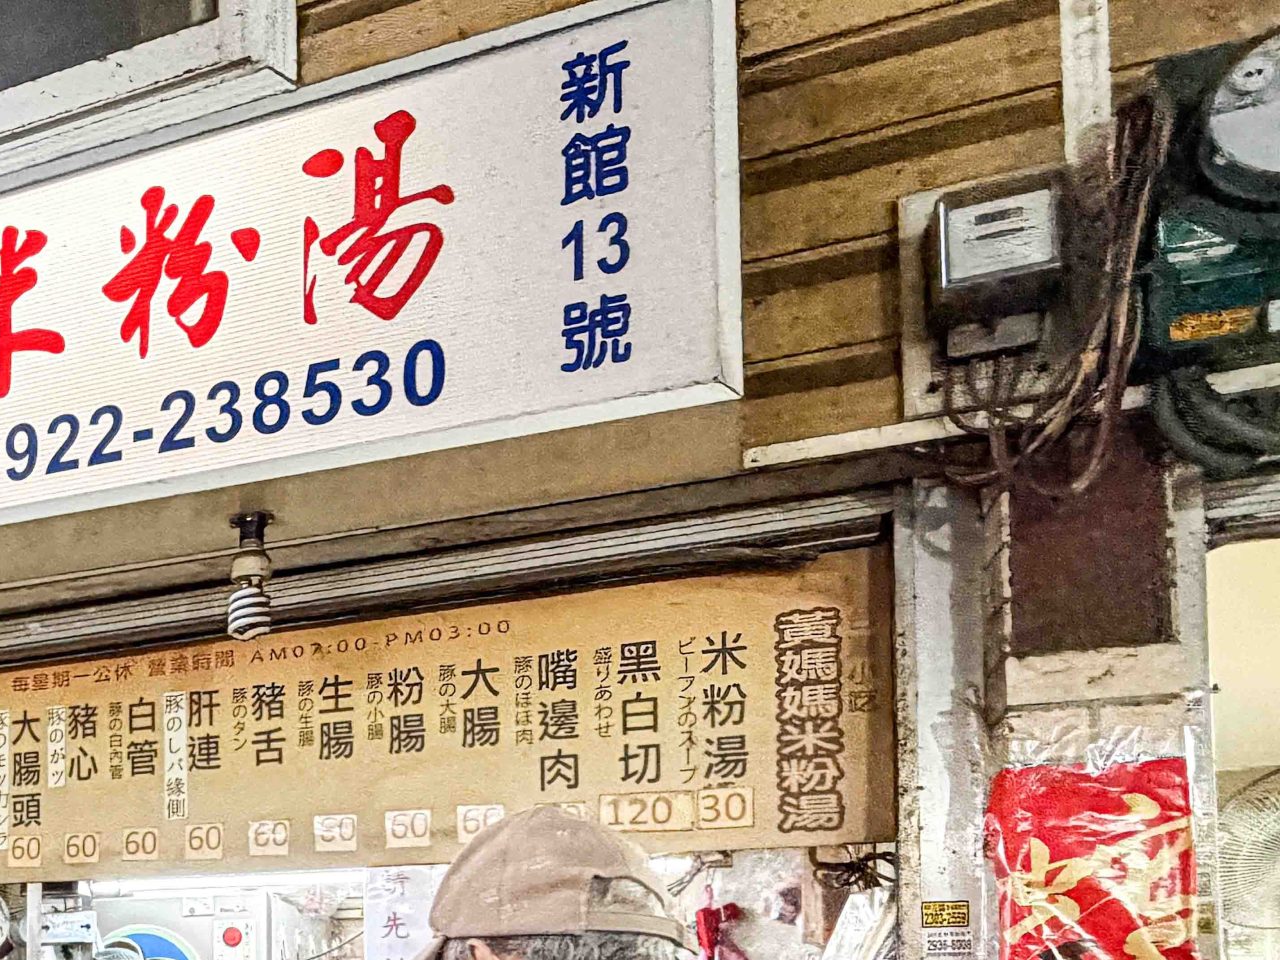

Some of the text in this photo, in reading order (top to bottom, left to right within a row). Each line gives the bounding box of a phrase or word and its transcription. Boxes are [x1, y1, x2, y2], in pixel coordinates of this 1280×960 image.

[560, 39, 632, 373] 新館13號
[10, 661, 134, 692] 每星期一公休
[318, 674, 355, 761] 生腸
[386, 666, 426, 755] 粉腸
[460, 658, 502, 748] 大腸
[592, 646, 616, 739] 盛りあわせ
[617, 640, 662, 785] 黑白切
[700, 631, 749, 779] 米粉湯
[67, 703, 98, 782] 豬心
[126, 696, 159, 777] 白管
[187, 689, 222, 773] 肝連
[251, 682, 286, 767] 豬舌
[537, 648, 580, 792] 嘴邊肉
[775, 606, 846, 835] 黃媽媽米粉湯
[11, 709, 42, 828] 大腸頭
[607, 794, 673, 826] 120
[701, 793, 747, 823] 30
[11, 837, 41, 860] 60
[66, 834, 97, 859] 60
[124, 830, 157, 855] 60
[188, 825, 222, 851] 60
